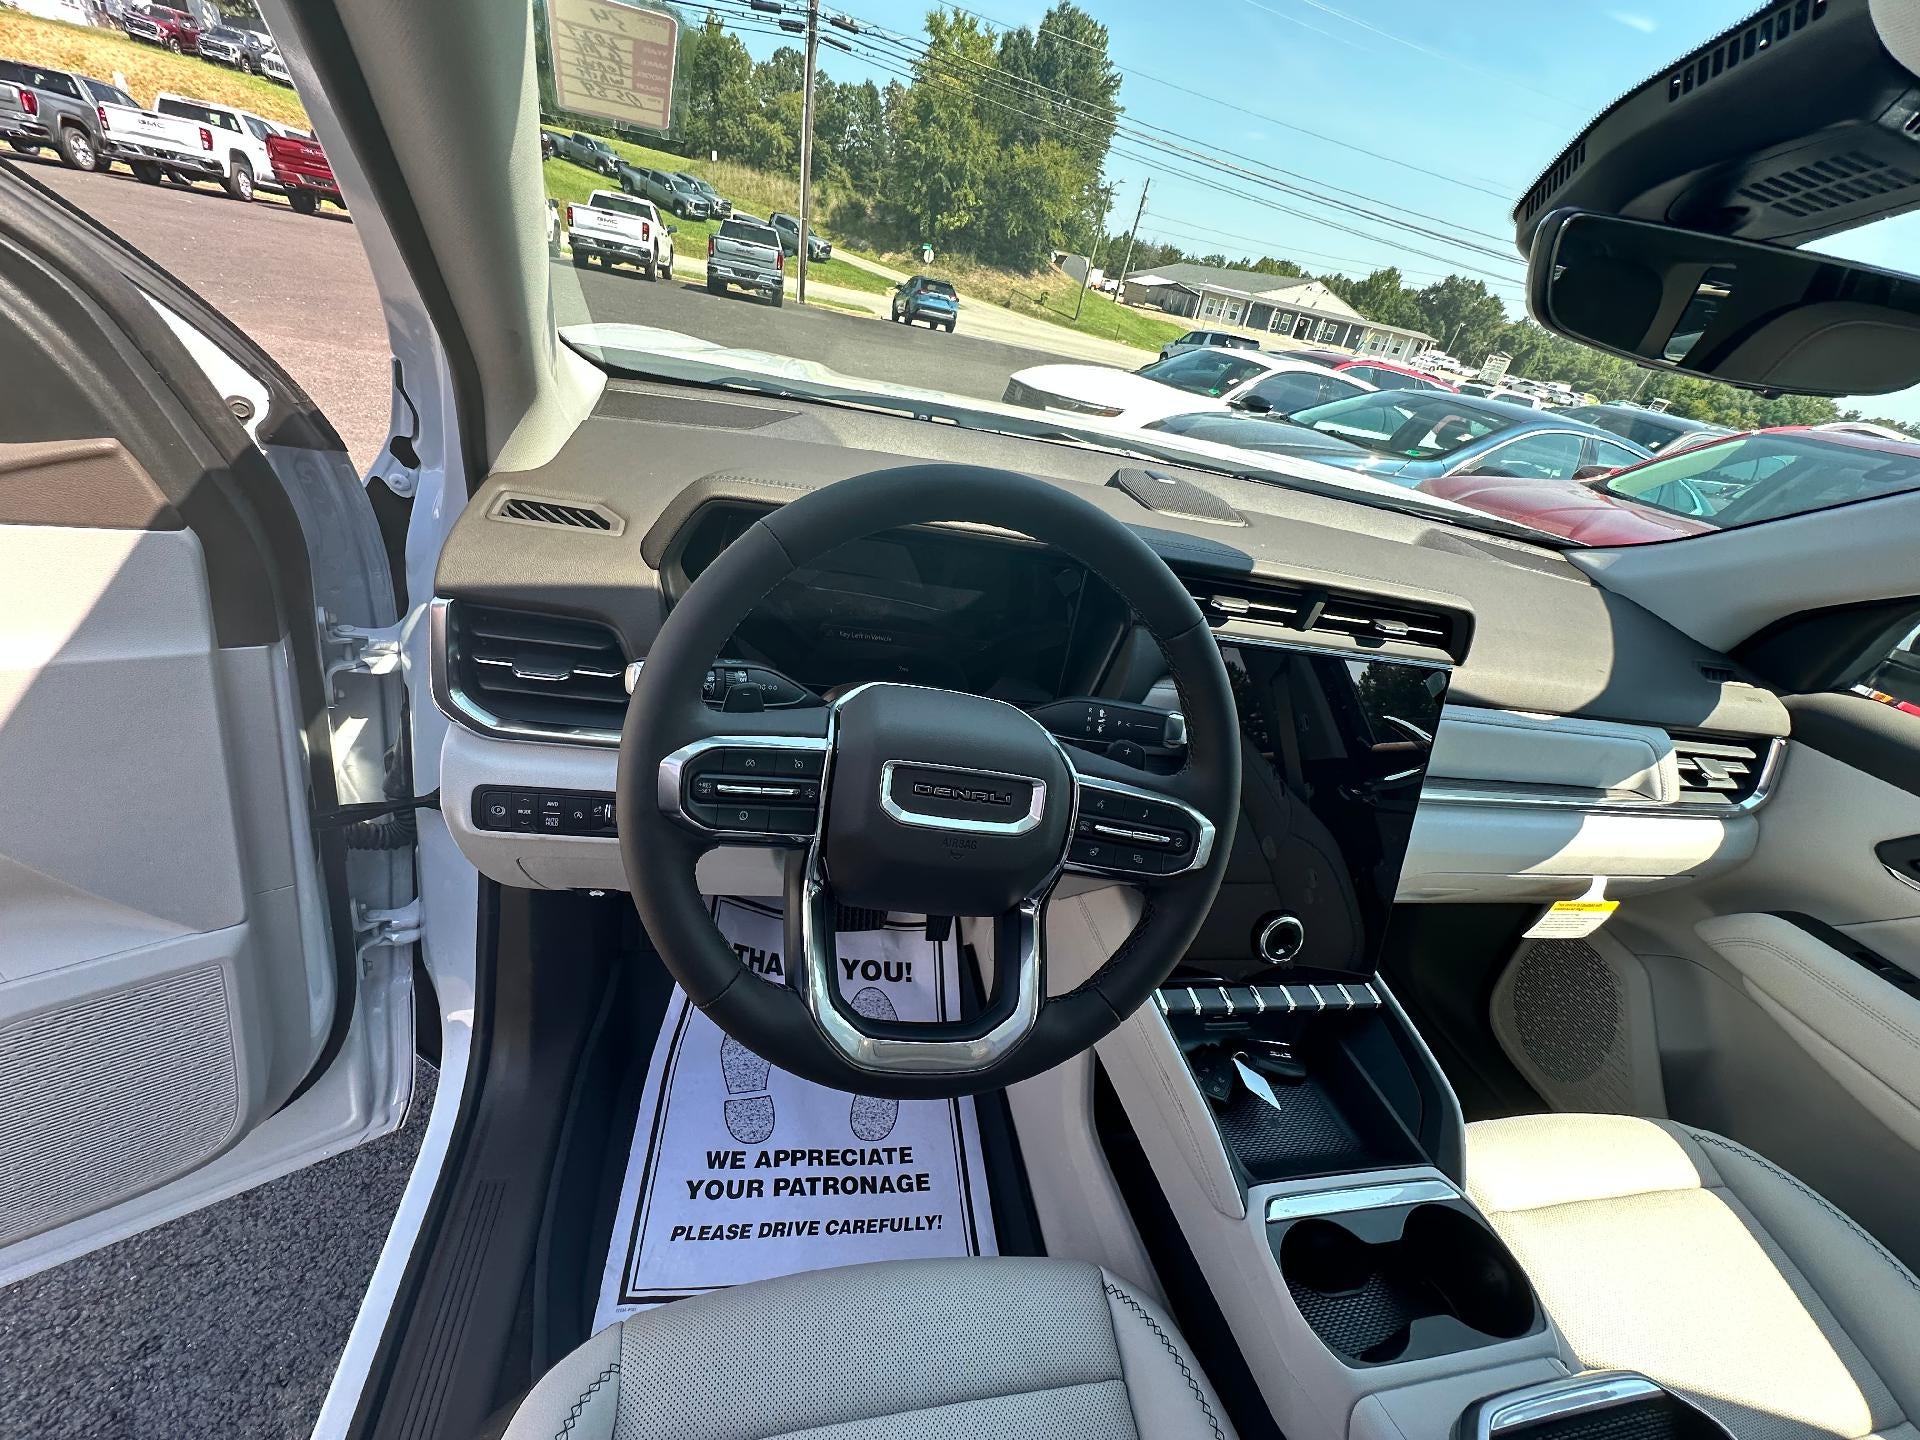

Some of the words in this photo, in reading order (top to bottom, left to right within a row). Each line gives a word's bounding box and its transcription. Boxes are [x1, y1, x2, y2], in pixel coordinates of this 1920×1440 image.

[913, 782, 1013, 805] DENALI
[942, 838, 978, 850] AIRBAG
[733, 943, 785, 977] THA
[840, 958, 913, 983] YOU!
[706, 1150, 746, 1170] WE
[754, 1146, 914, 1169] APPRECIATE
[686, 1179, 764, 1200] YOUR
[773, 1173, 931, 1198] PATRONAGE
[670, 1222, 752, 1242] PLEASE
[758, 1219, 821, 1239] DRIVE
[825, 1214, 943, 1236] CAREFULLY!
